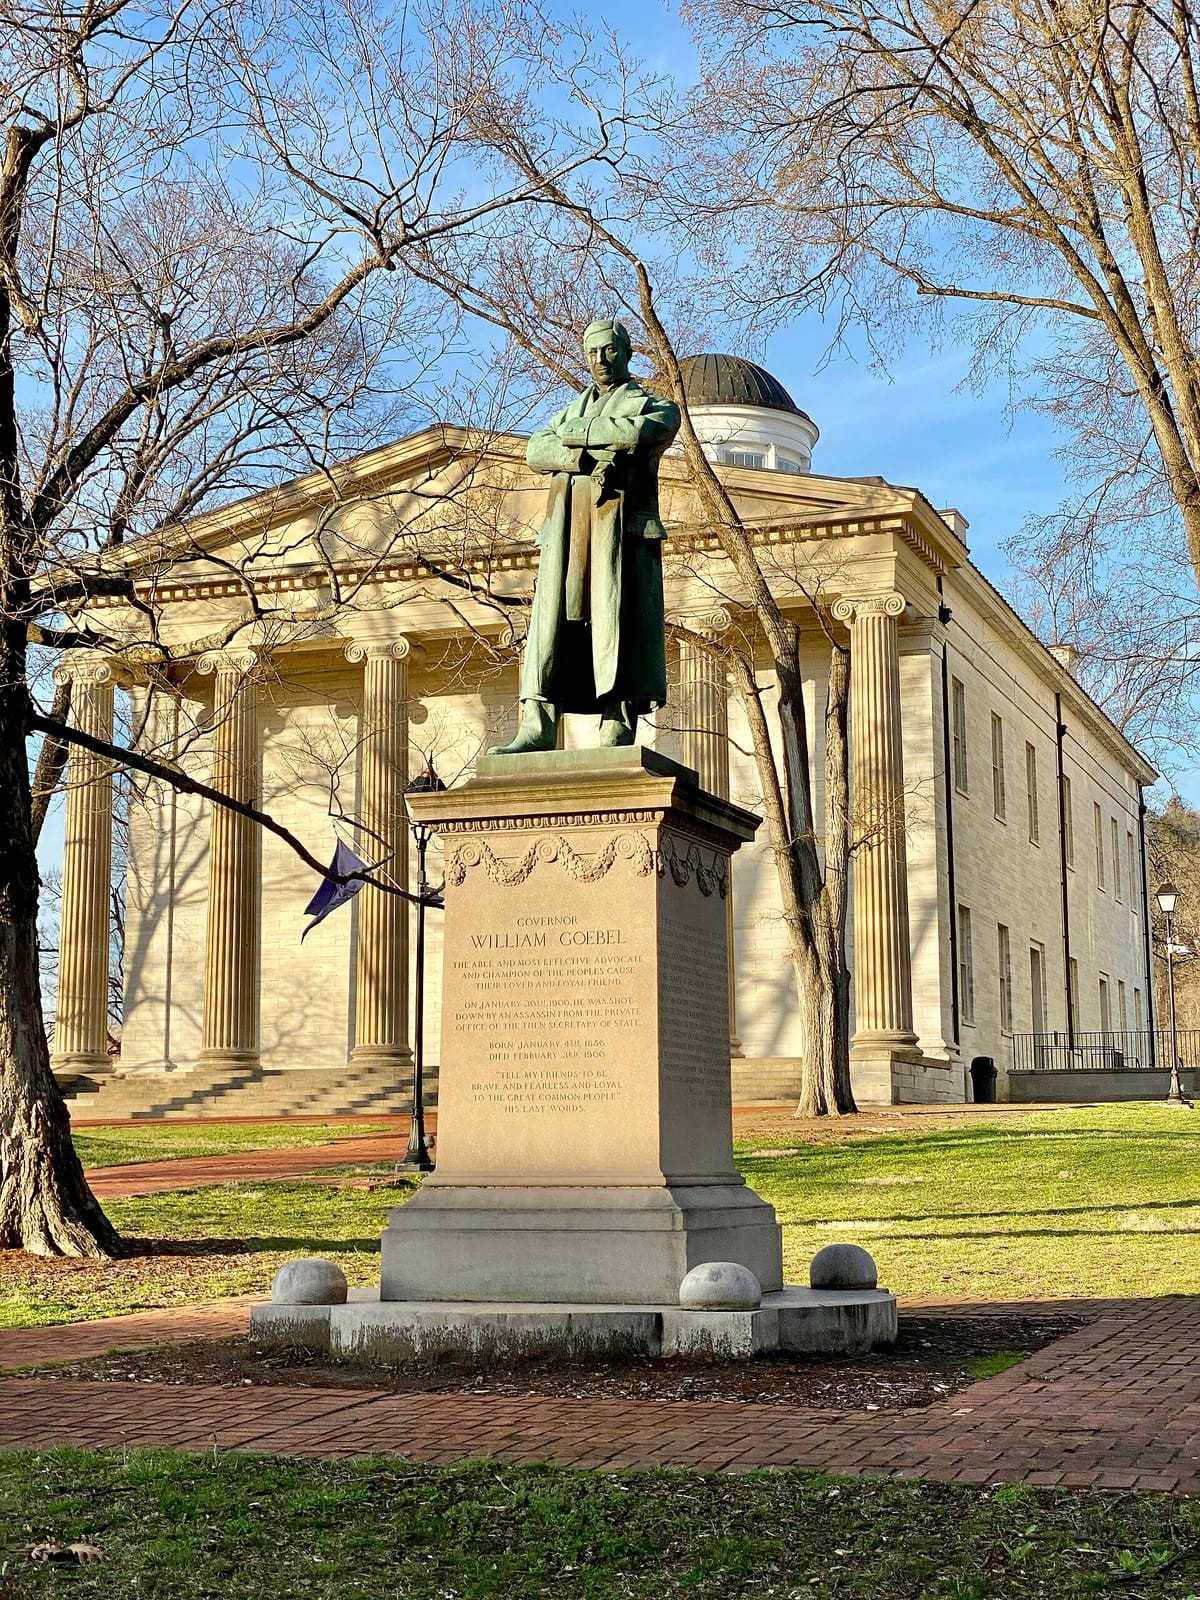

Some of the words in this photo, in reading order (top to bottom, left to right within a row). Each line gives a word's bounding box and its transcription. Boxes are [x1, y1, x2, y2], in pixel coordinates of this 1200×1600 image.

[517, 916, 578, 927] GOVERNOR
[471, 933, 546, 949] WILLIAM
[560, 930, 626, 946] GOEBEL
[544, 957, 590, 966] EFFECTIVE
[595, 956, 641, 964] ADVOCATE
[483, 970, 530, 979] CHAMPION
[607, 966, 636, 975] CAUSE
[476, 982, 501, 990] THEIR
[558, 979, 586, 988] LOYAL
[479, 1000, 521, 1010] JANUARY
[609, 997, 633, 1005] SHOT
[456, 1012, 483, 1020] DOWN
[513, 1011, 556, 1019] ASSASSIN
[558, 1010, 583, 1018] FROM
[605, 1008, 641, 1016] PRIVATE
[456, 1023, 486, 1031] OFFICE
[548, 1020, 597, 1029] SECRETARY
[518, 1040, 560, 1049] JANUARY
[584, 1040, 606, 1048] 1856
[513, 1052, 558, 1060] FEBRUARY
[584, 1051, 606, 1059] 1900
[496, 1071, 521, 1079] "TELL
[540, 1071, 578, 1079] FRIENDS
[524, 1082, 569, 1090] FEARLESS
[594, 1081, 623, 1089] LOYAL
[538, 1093, 581, 1101] COMMON
[505, 1105, 520, 1113] HIS
[523, 1105, 545, 1113] LAST
[550, 1104, 586, 1113] WORDS.
